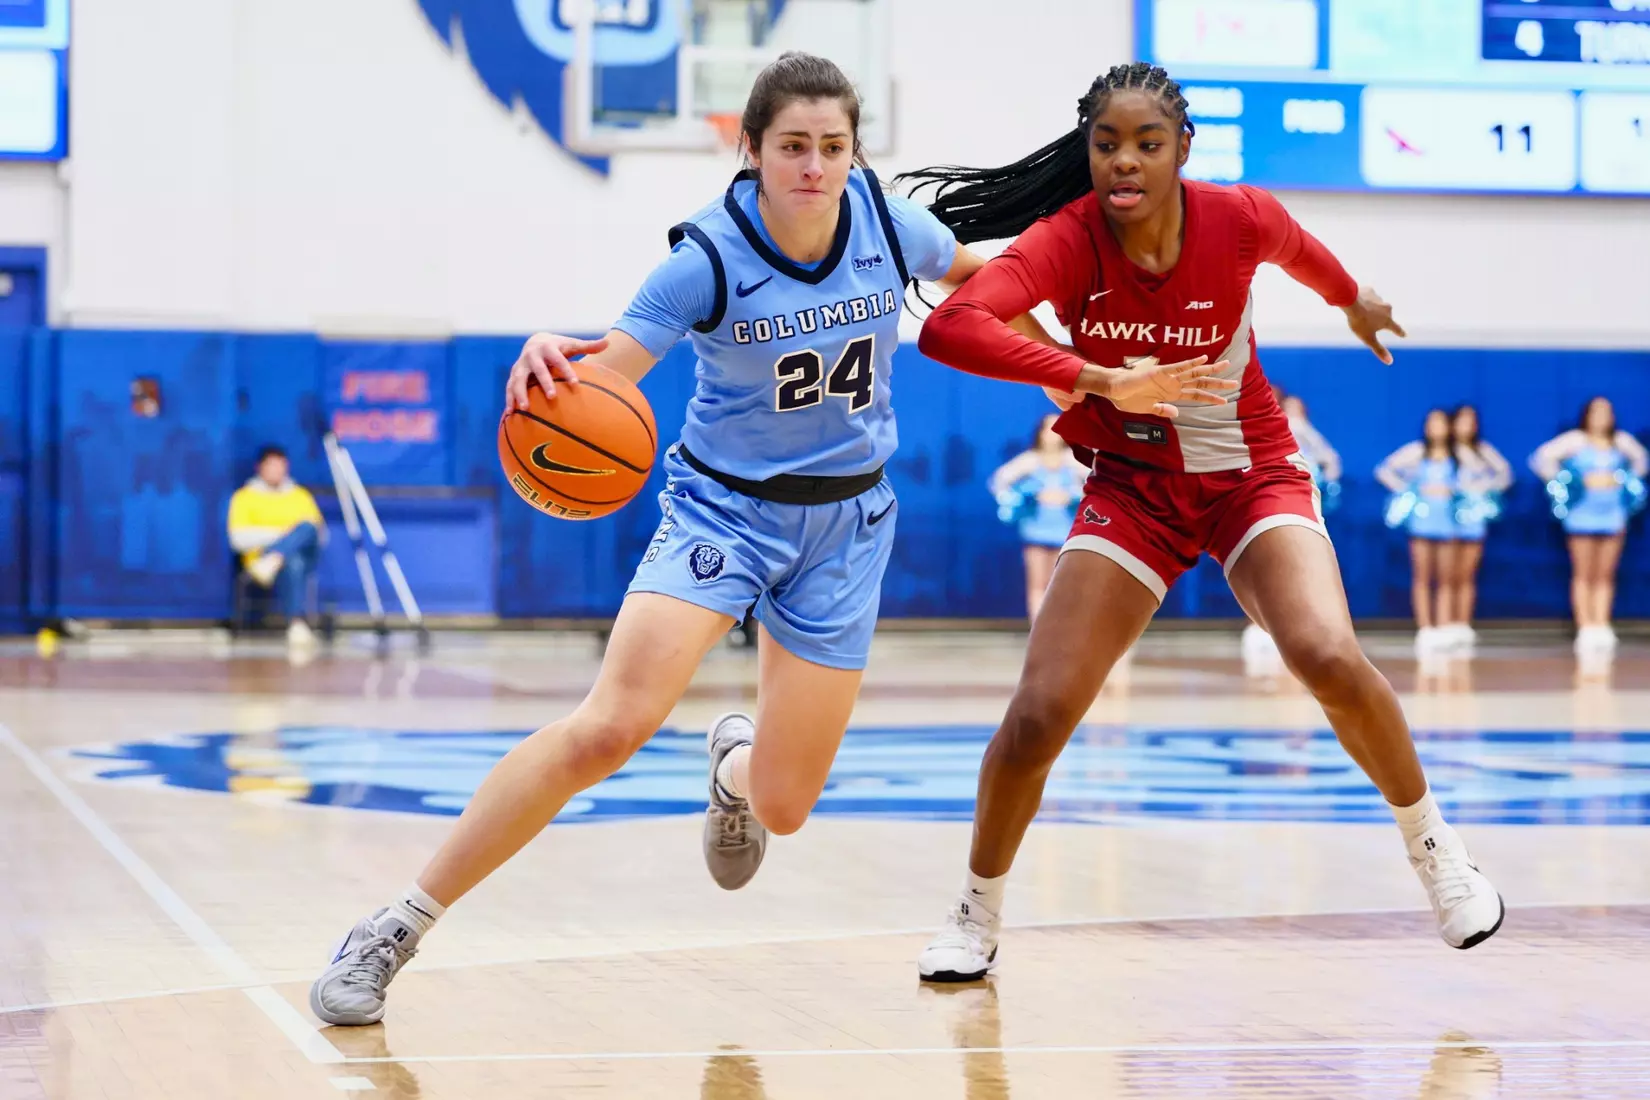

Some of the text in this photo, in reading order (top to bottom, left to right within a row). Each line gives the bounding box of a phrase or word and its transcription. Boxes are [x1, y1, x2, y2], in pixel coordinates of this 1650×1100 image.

[1489, 123, 1532, 153] 11
[733, 289, 897, 345] COLUMBIA
[1080, 317, 1226, 347] HAWK HILL
[773, 332, 876, 415] 24
[512, 472, 592, 519] ELITE
